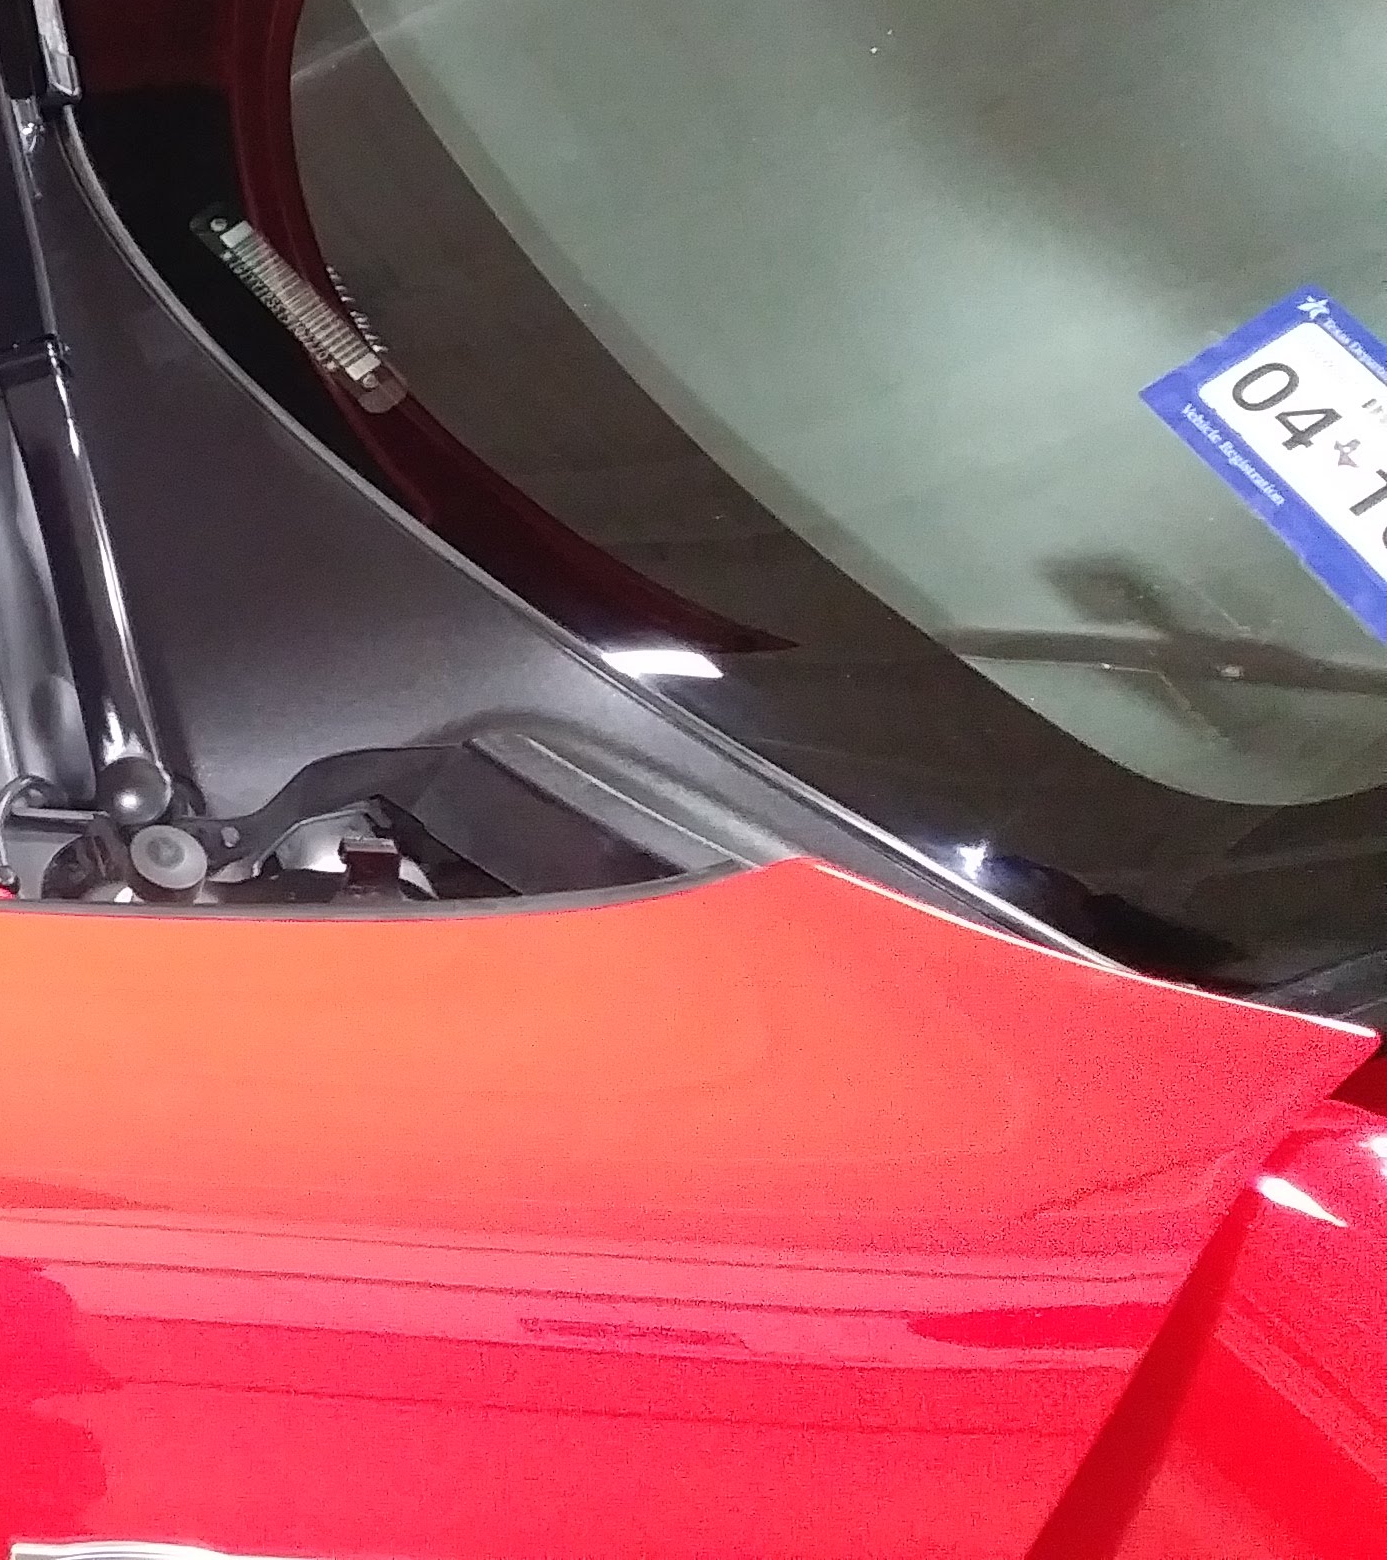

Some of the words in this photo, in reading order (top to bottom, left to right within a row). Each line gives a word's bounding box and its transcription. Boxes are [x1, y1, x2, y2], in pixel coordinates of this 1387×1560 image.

[1180, 402, 1224, 444] Vehicle
[1218, 439, 1286, 507] Registration
[1232, 362, 1343, 451] 04
